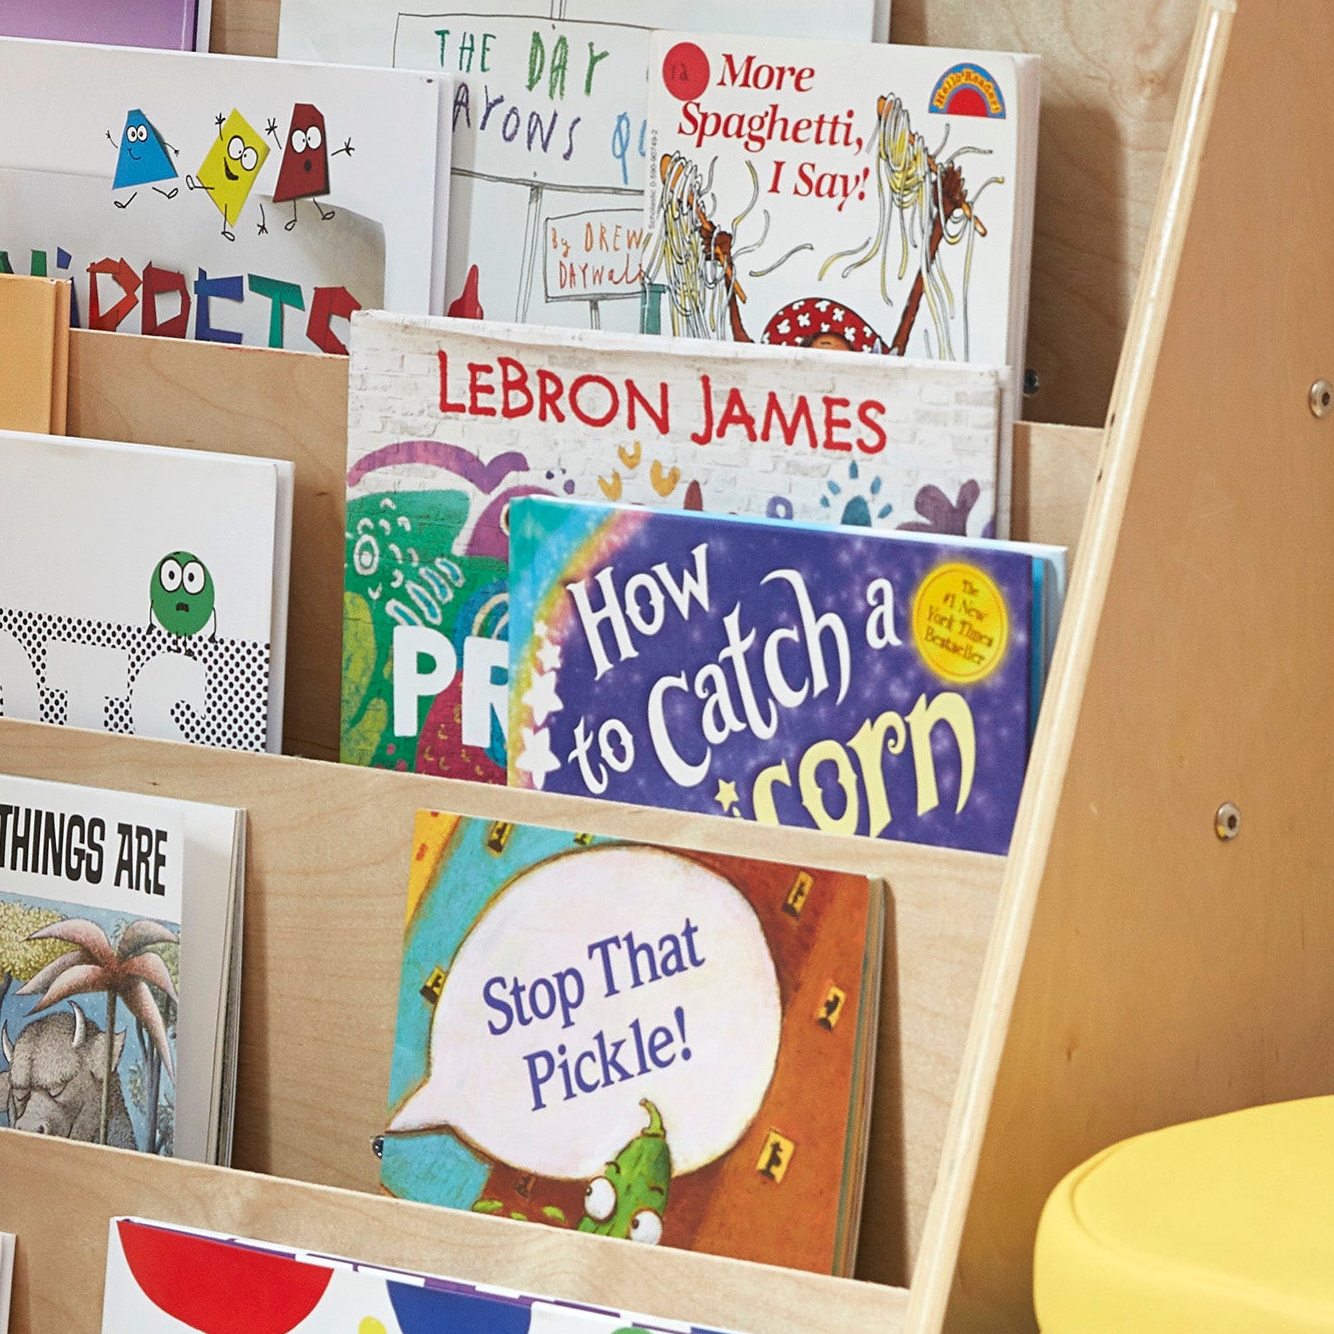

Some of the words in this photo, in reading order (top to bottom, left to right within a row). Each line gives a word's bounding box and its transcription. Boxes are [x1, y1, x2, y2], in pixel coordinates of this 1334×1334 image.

[434, 29, 497, 73] THE
[525, 30, 609, 100] DAY
[716, 53, 815, 93] More
[452, 81, 581, 161] AYONS
[677, 101, 864, 156] Spaghetti,
[768, 160, 786, 194] I
[793, 162, 871, 212] Say!
[551, 227, 571, 258] By
[584, 221, 644, 252] DREW
[437, 350, 671, 435] LEBRON
[690, 374, 888, 455] JAMES
[566, 543, 711, 681] How
[568, 716, 635, 794] to
[648, 569, 851, 788] Catch
[866, 578, 903, 650] a
[114, 823, 168, 896] ARE
[482, 967, 584, 1036] Stop
[588, 917, 705, 998] That
[523, 1006, 693, 1111] Pickle!
